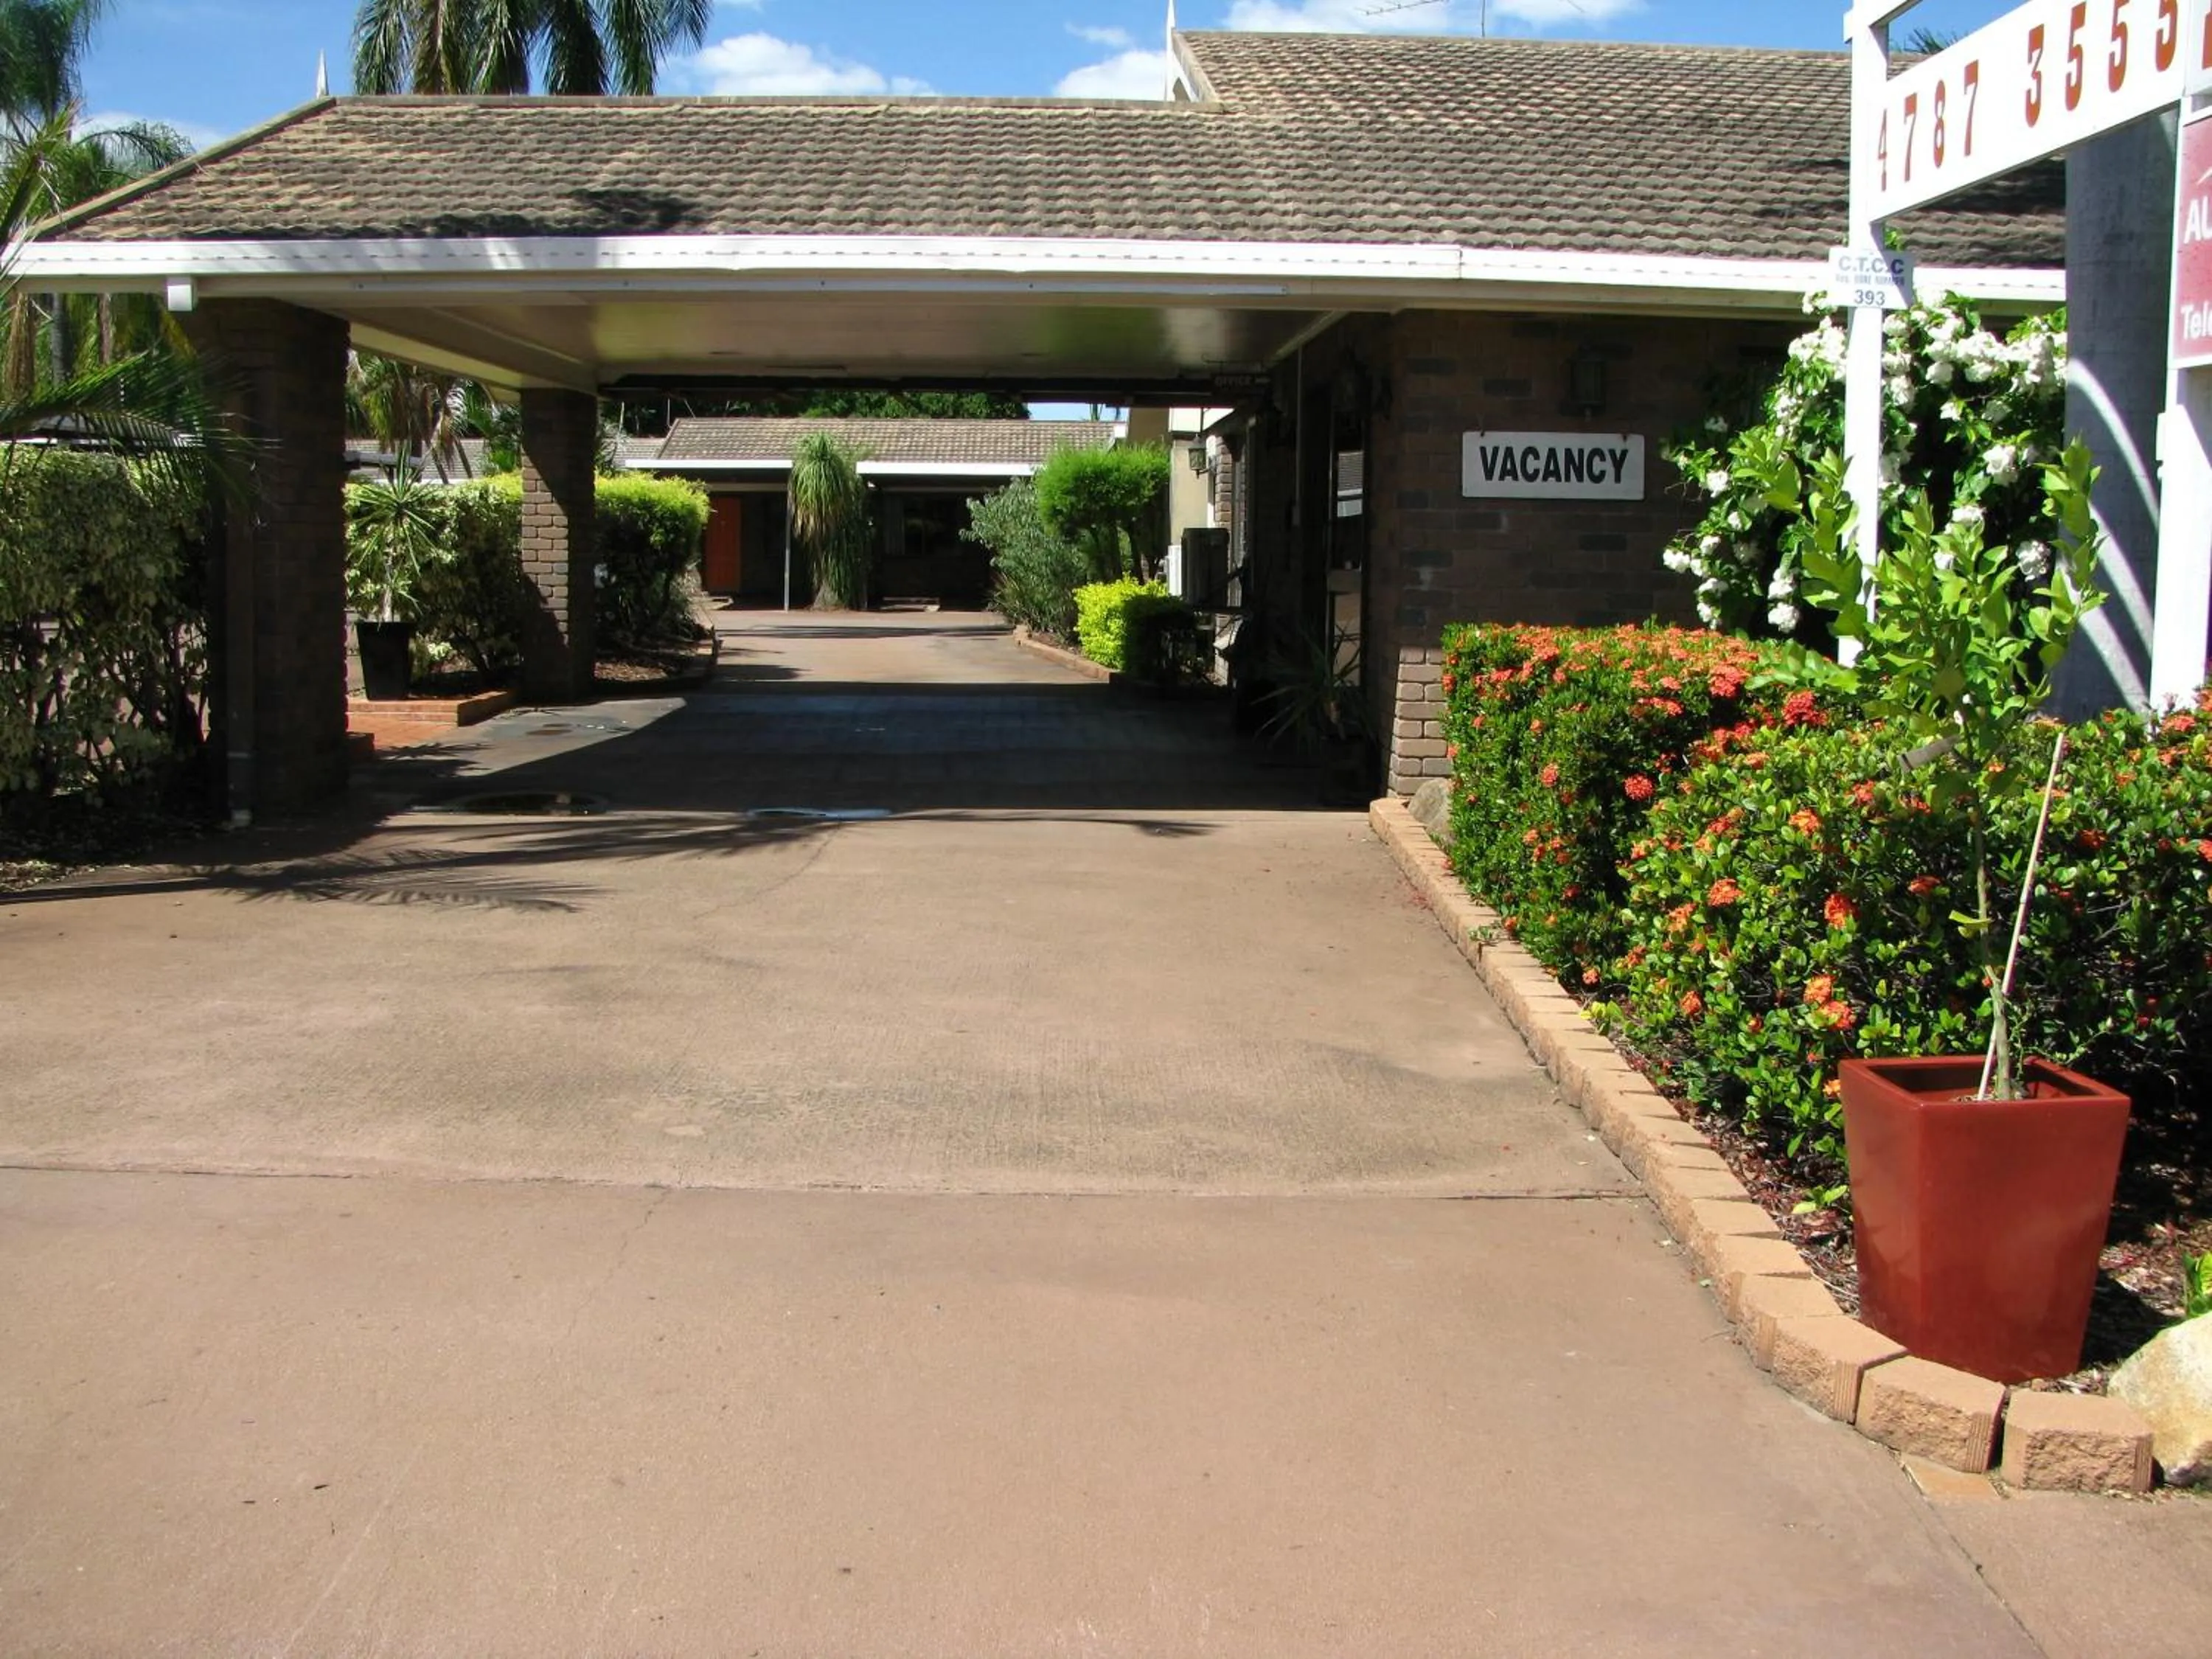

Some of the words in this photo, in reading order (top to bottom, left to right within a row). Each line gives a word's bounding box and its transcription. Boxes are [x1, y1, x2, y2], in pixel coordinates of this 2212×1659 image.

[1877, 59, 1979, 192] 4787
[1854, 288, 1886, 305] 393
[1479, 445, 1629, 484] VACANCY
